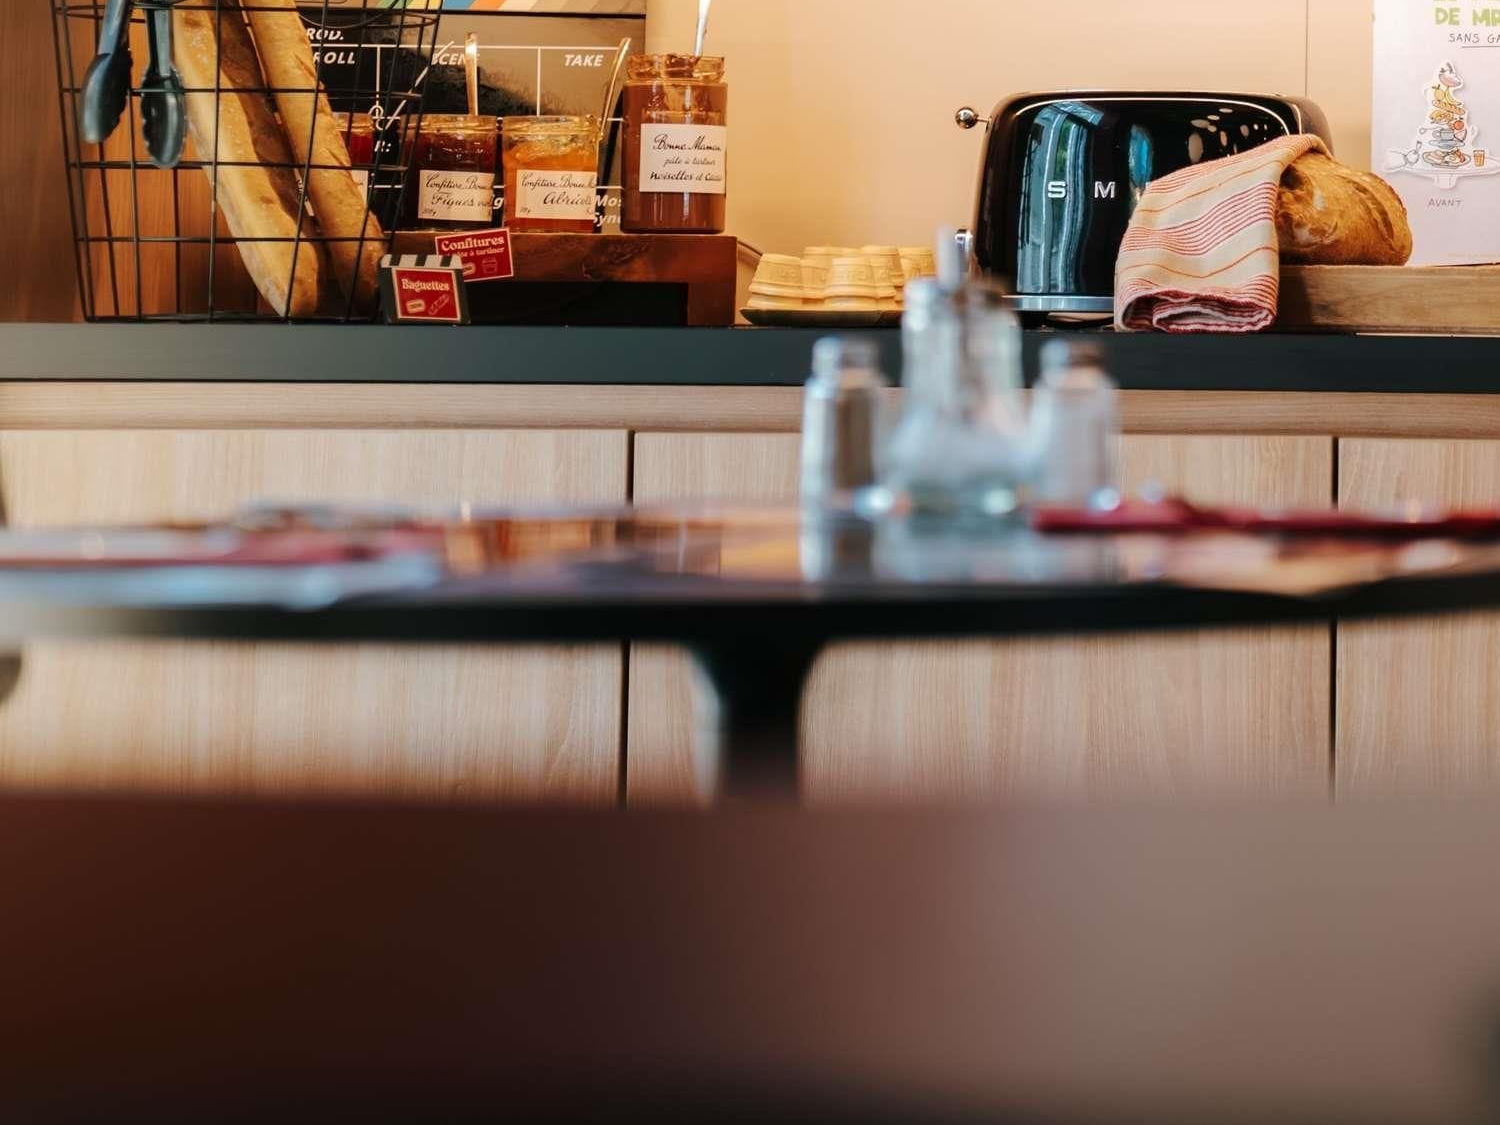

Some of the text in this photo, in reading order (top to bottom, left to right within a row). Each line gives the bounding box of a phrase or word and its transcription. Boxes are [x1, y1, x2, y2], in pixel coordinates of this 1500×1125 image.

[1434, 7, 1461, 26] DE
[1448, 33, 1480, 44] SANS
[431, 52, 480, 66] SCEN
[564, 54, 604, 67] TAKE
[652, 133, 687, 151] Bonne
[1428, 198, 1462, 208] AVANT
[441, 236, 505, 252] Confitures
[401, 278, 450, 293] Baguettes
